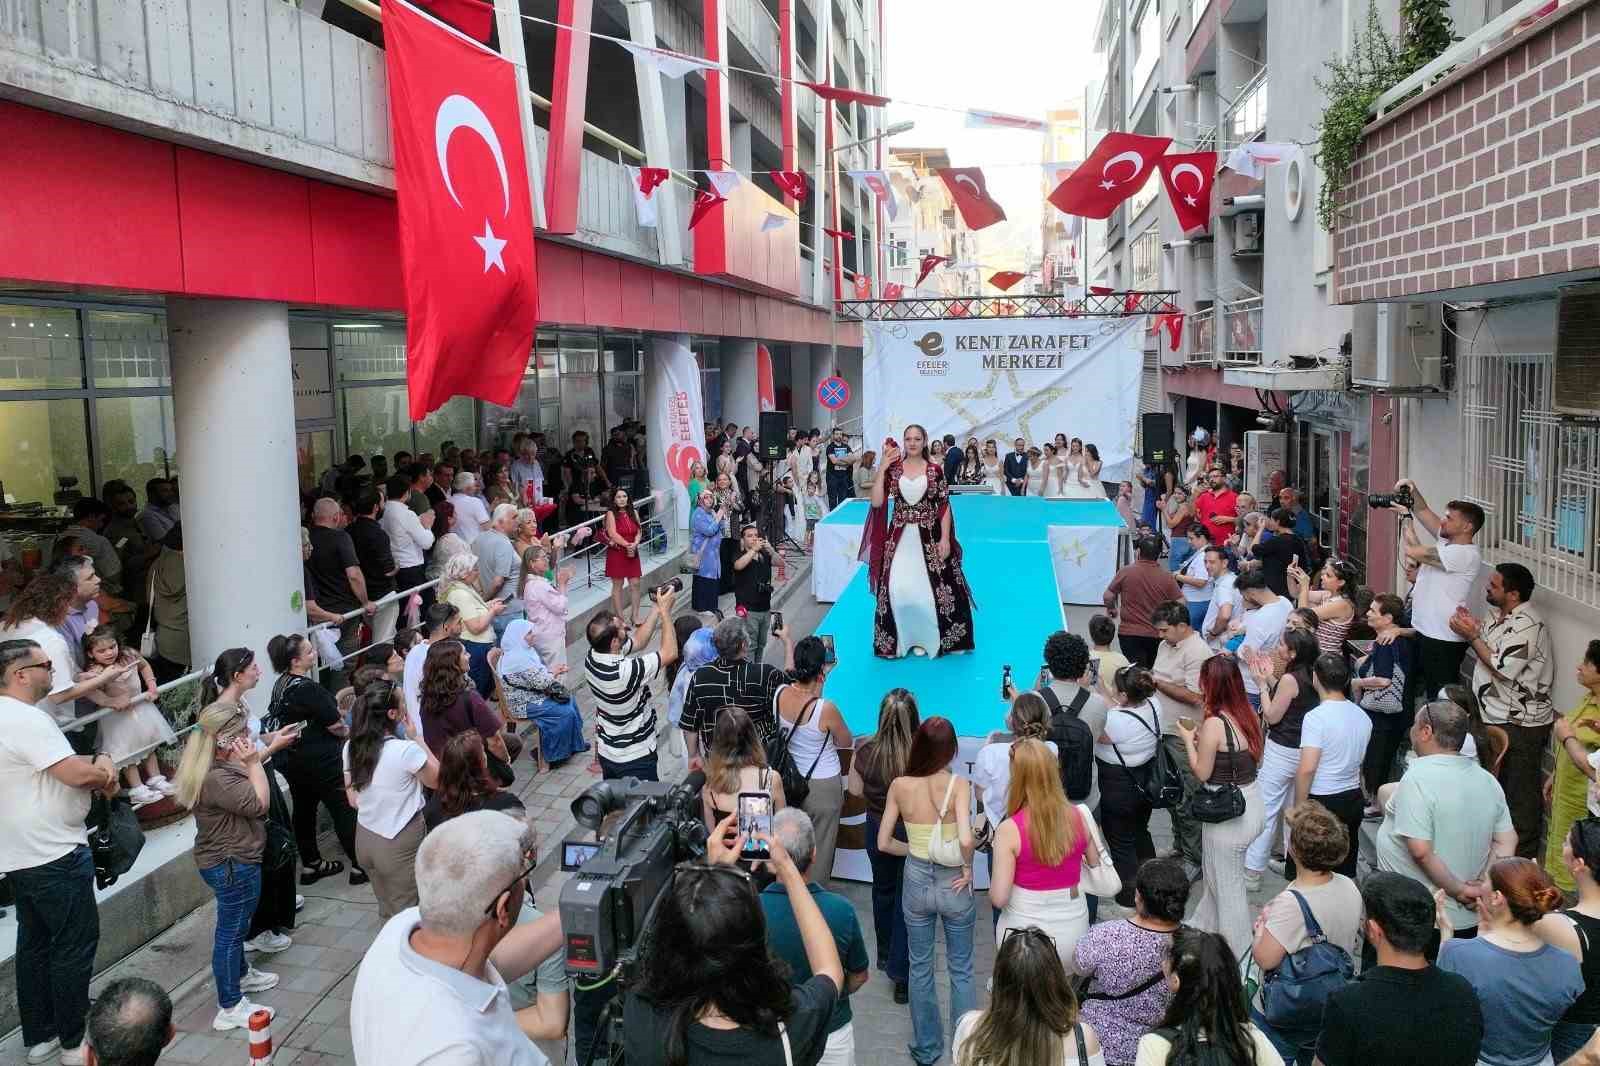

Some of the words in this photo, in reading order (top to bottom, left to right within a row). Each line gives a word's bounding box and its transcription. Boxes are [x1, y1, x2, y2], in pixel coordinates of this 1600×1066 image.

[955, 335, 1002, 350] KENT
[1008, 334, 1091, 350] ZARAFET
[982, 351, 1063, 369] MERKEZİ
